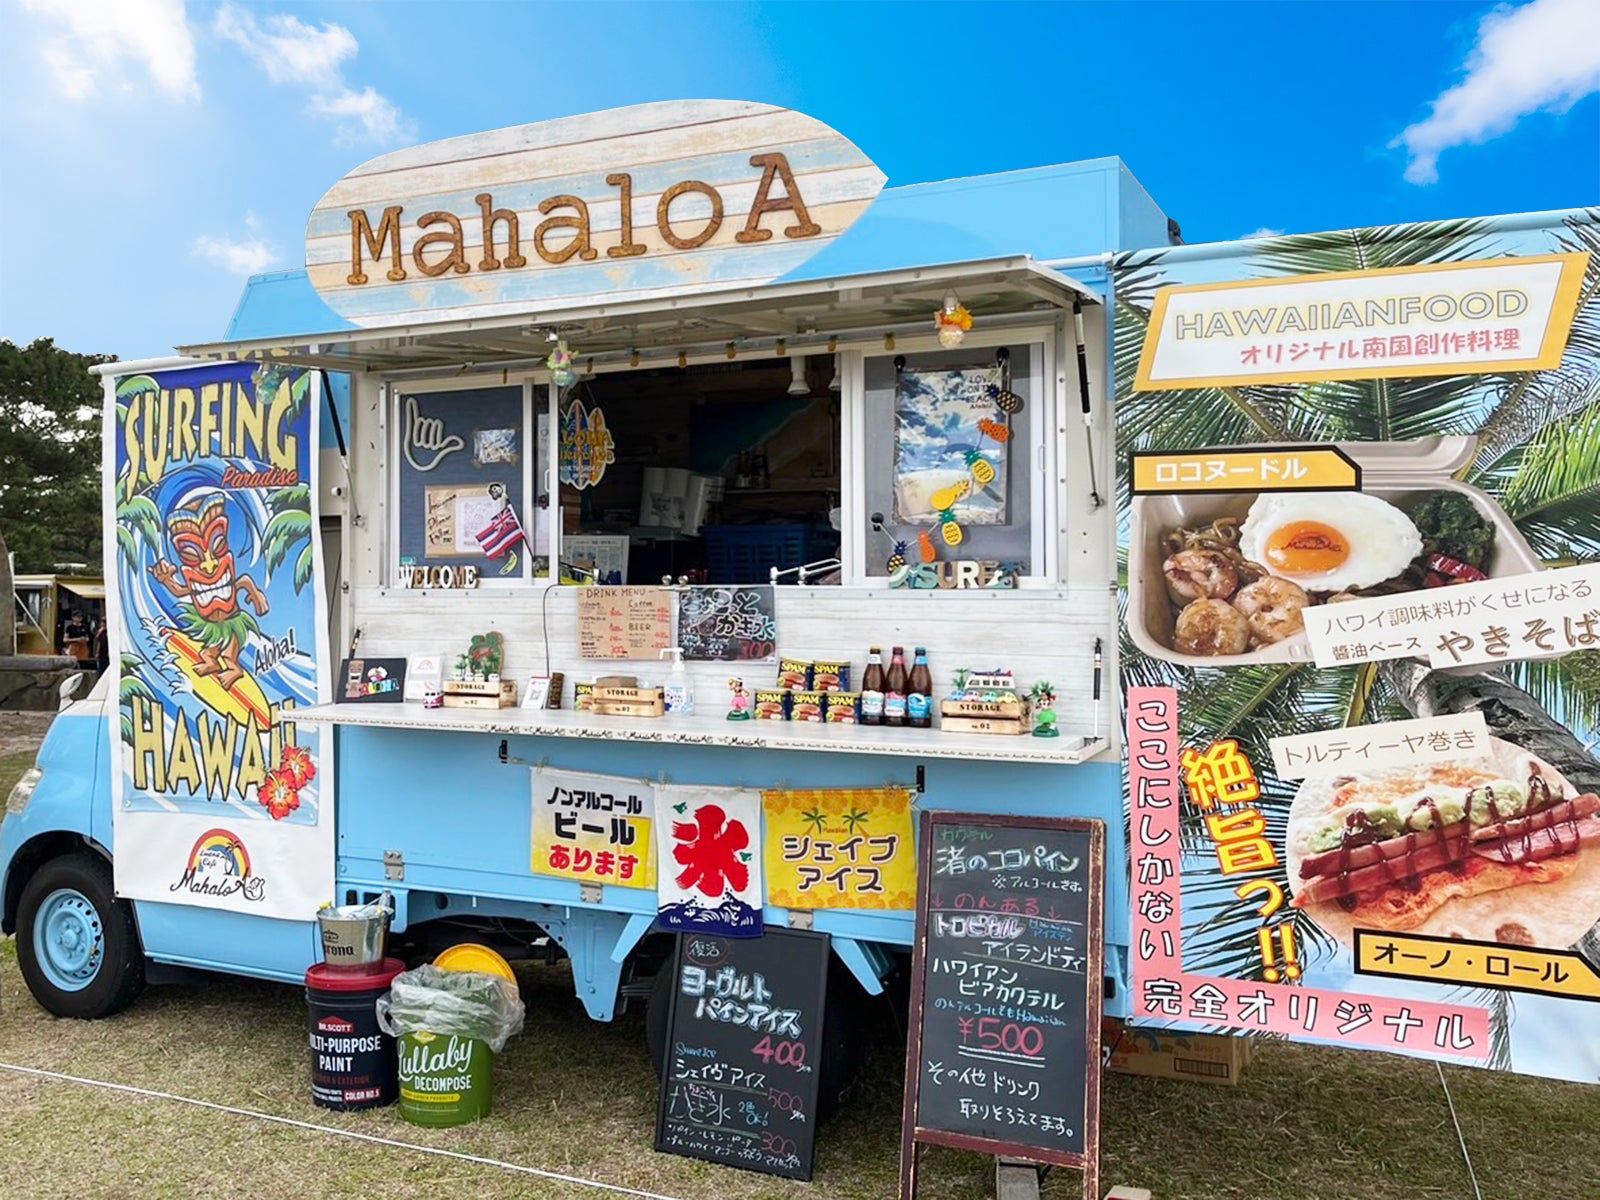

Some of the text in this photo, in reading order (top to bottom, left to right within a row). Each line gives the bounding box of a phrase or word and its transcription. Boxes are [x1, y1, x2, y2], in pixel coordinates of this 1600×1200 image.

[347, 152, 821, 285] MahaloA
[1240, 328, 1520, 366] オリジナル南国創作料理
[125, 377, 299, 505] SURFING
[221, 463, 298, 489] Paradise
[1155, 458, 1308, 483] ロコヌードル
[399, 564, 478, 589] WELCOME
[586, 587, 646, 598] DRINK MENU
[1325, 580, 1593, 636] ハワイ調味料がくせになる
[1436, 609, 1600, 663] やきそば
[254, 628, 296, 676] Aloha!
[781, 663, 806, 674] SPAM
[814, 665, 839, 674] SPAM
[577, 686, 593, 695] SPA
[606, 689, 638, 697] STORAGE
[757, 693, 781, 703] SPAM
[794, 695, 819, 704] SPAM
[828, 696, 854, 706] SPAM
[960, 703, 1001, 712] STORAGE
[1283, 728, 1477, 767] トルティーヤ巻き
[547, 786, 642, 815] ノンアルコール
[554, 811, 636, 846] ビール
[1135, 699, 1175, 961] ここにしかない
[549, 844, 639, 880] あります
[672, 804, 750, 898] 氷
[784, 836, 897, 862] シェイブ
[936, 845, 1080, 875] 渚のココパイン
[798, 867, 883, 892] アイス
[935, 912, 1026, 940] トロピカル
[325, 945, 354, 956] rona
[1373, 942, 1569, 985] オーノ・ロール
[682, 965, 772, 1002] ヨーグルト
[933, 957, 1018, 984] ハワイアン
[959, 979, 1065, 1011] ビアカクテル
[693, 996, 802, 1039] パインアイス
[1143, 978, 1475, 1051] 完全オリジナル
[309, 1032, 382, 1054] ULTI-PURPOSE
[752, 1036, 806, 1066] 400
[319, 1055, 353, 1072] PAINT
[398, 1034, 473, 1082] Lullaby
[414, 1074, 472, 1092] DECOMPOSE
[768, 1088, 803, 1111] 500
